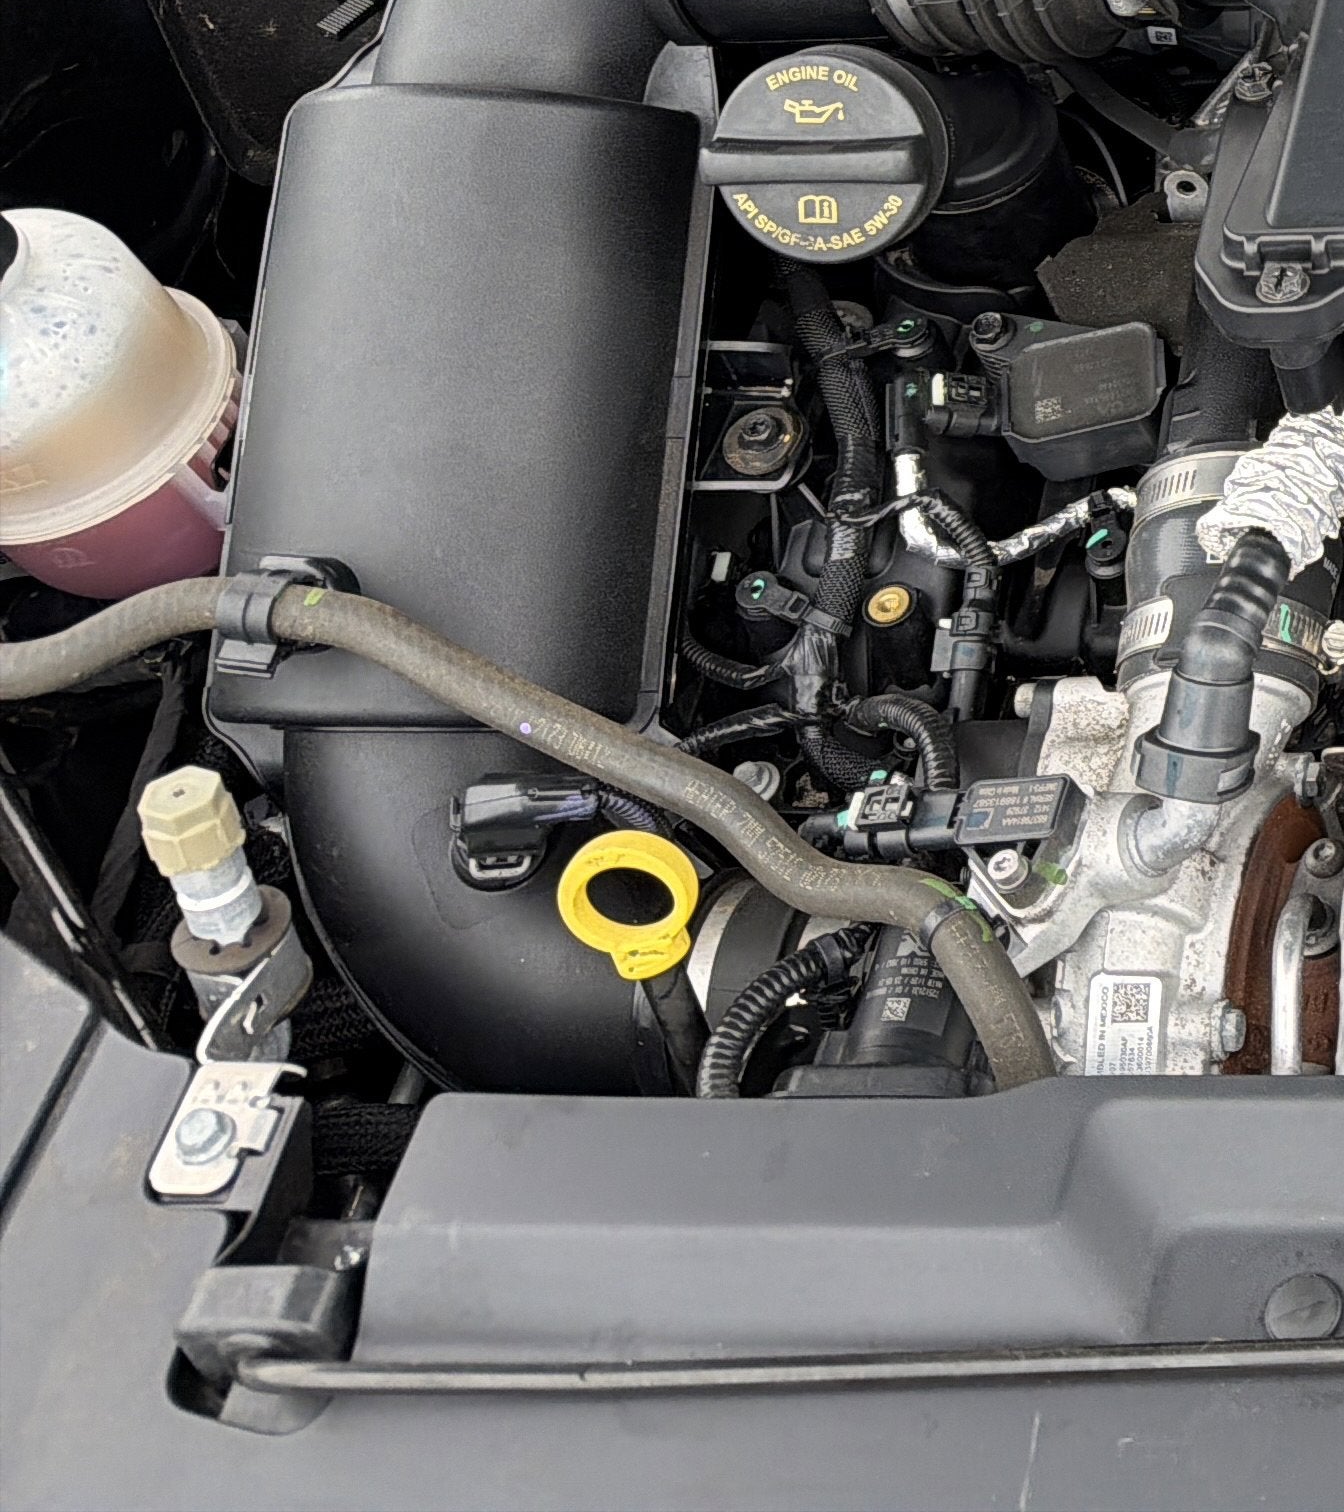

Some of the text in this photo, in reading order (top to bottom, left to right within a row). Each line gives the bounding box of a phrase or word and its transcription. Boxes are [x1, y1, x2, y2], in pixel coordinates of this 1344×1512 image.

[766, 65, 859, 92] ENGINE OIL
[733, 193, 757, 219] API
[863, 194, 904, 236] 5W-30
[1099, 986, 1110, 1041] IN MEXICO
